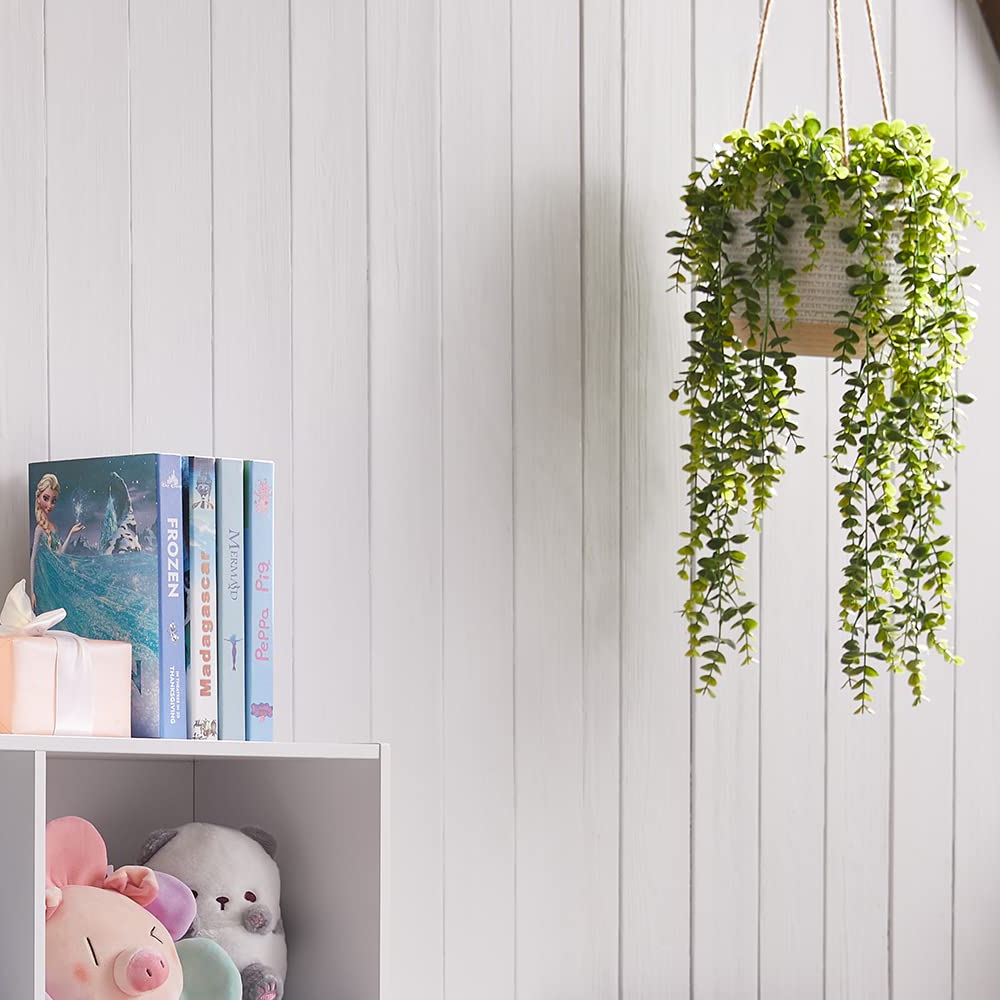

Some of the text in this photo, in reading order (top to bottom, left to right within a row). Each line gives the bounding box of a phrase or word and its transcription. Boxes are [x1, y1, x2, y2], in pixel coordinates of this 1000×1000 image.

[167, 517, 179, 598] FROZEN
[200, 551, 213, 697] Madagascar
[255, 561, 271, 661] Peppa Pig
